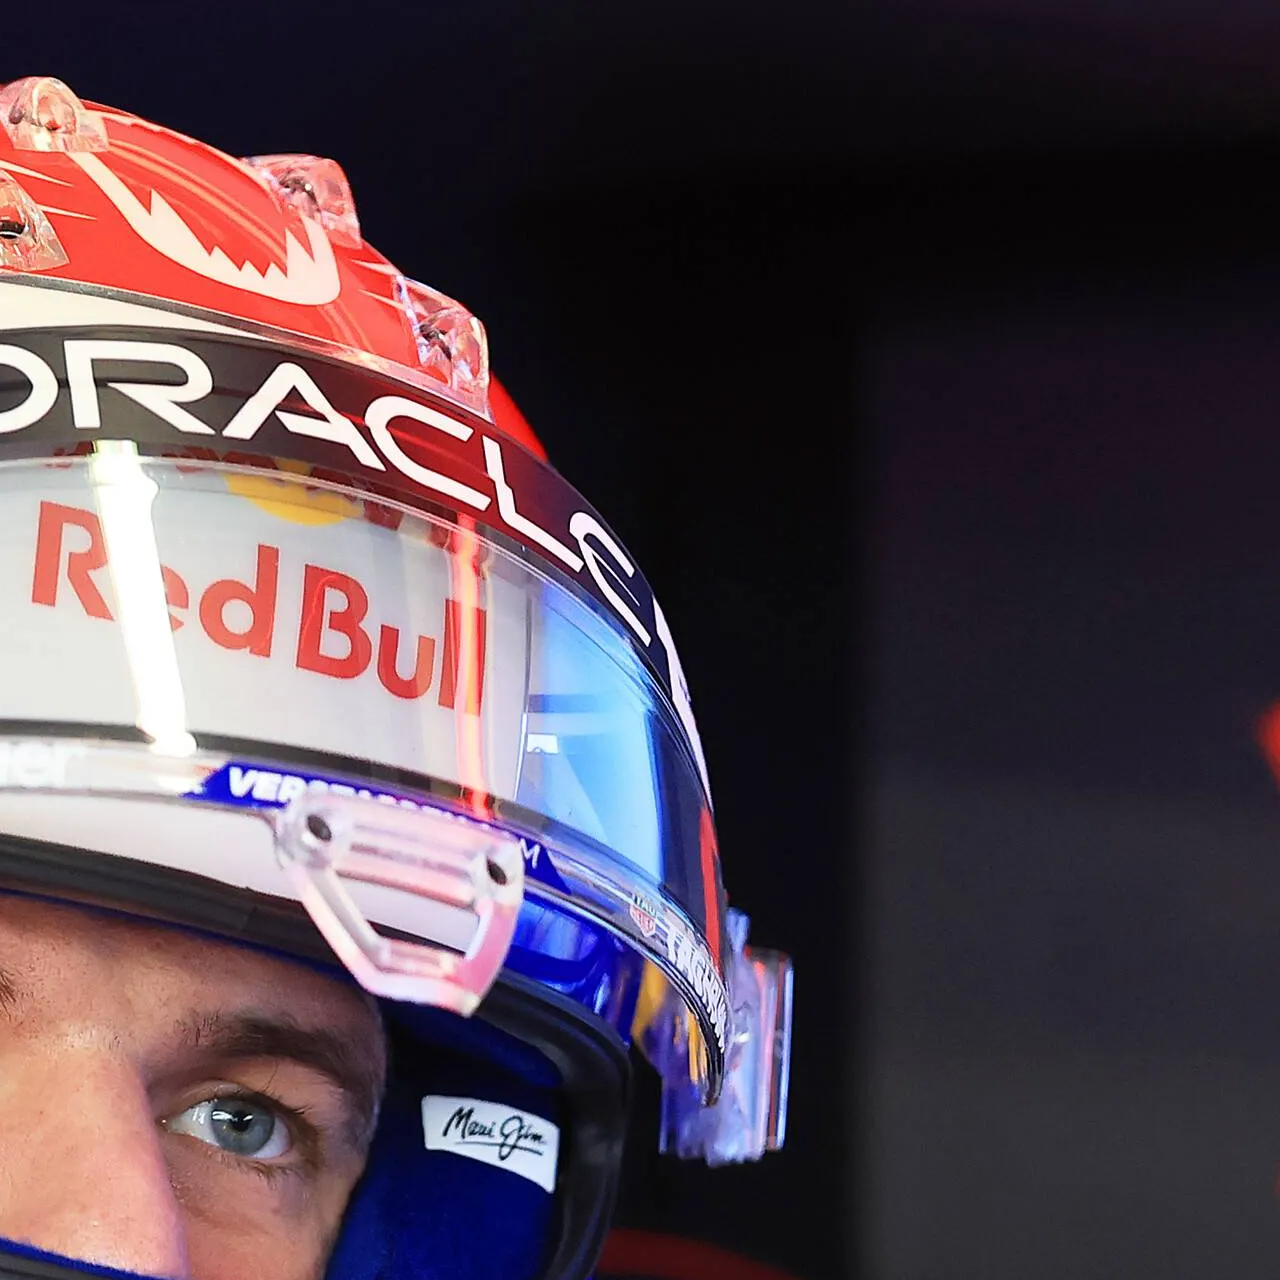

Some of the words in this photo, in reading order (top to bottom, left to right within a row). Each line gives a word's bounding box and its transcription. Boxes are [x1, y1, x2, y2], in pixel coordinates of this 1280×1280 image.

[296, 563, 488, 718] Bull
[442, 1106, 497, 1140] Maui
[498, 1115, 548, 1161] Jim
